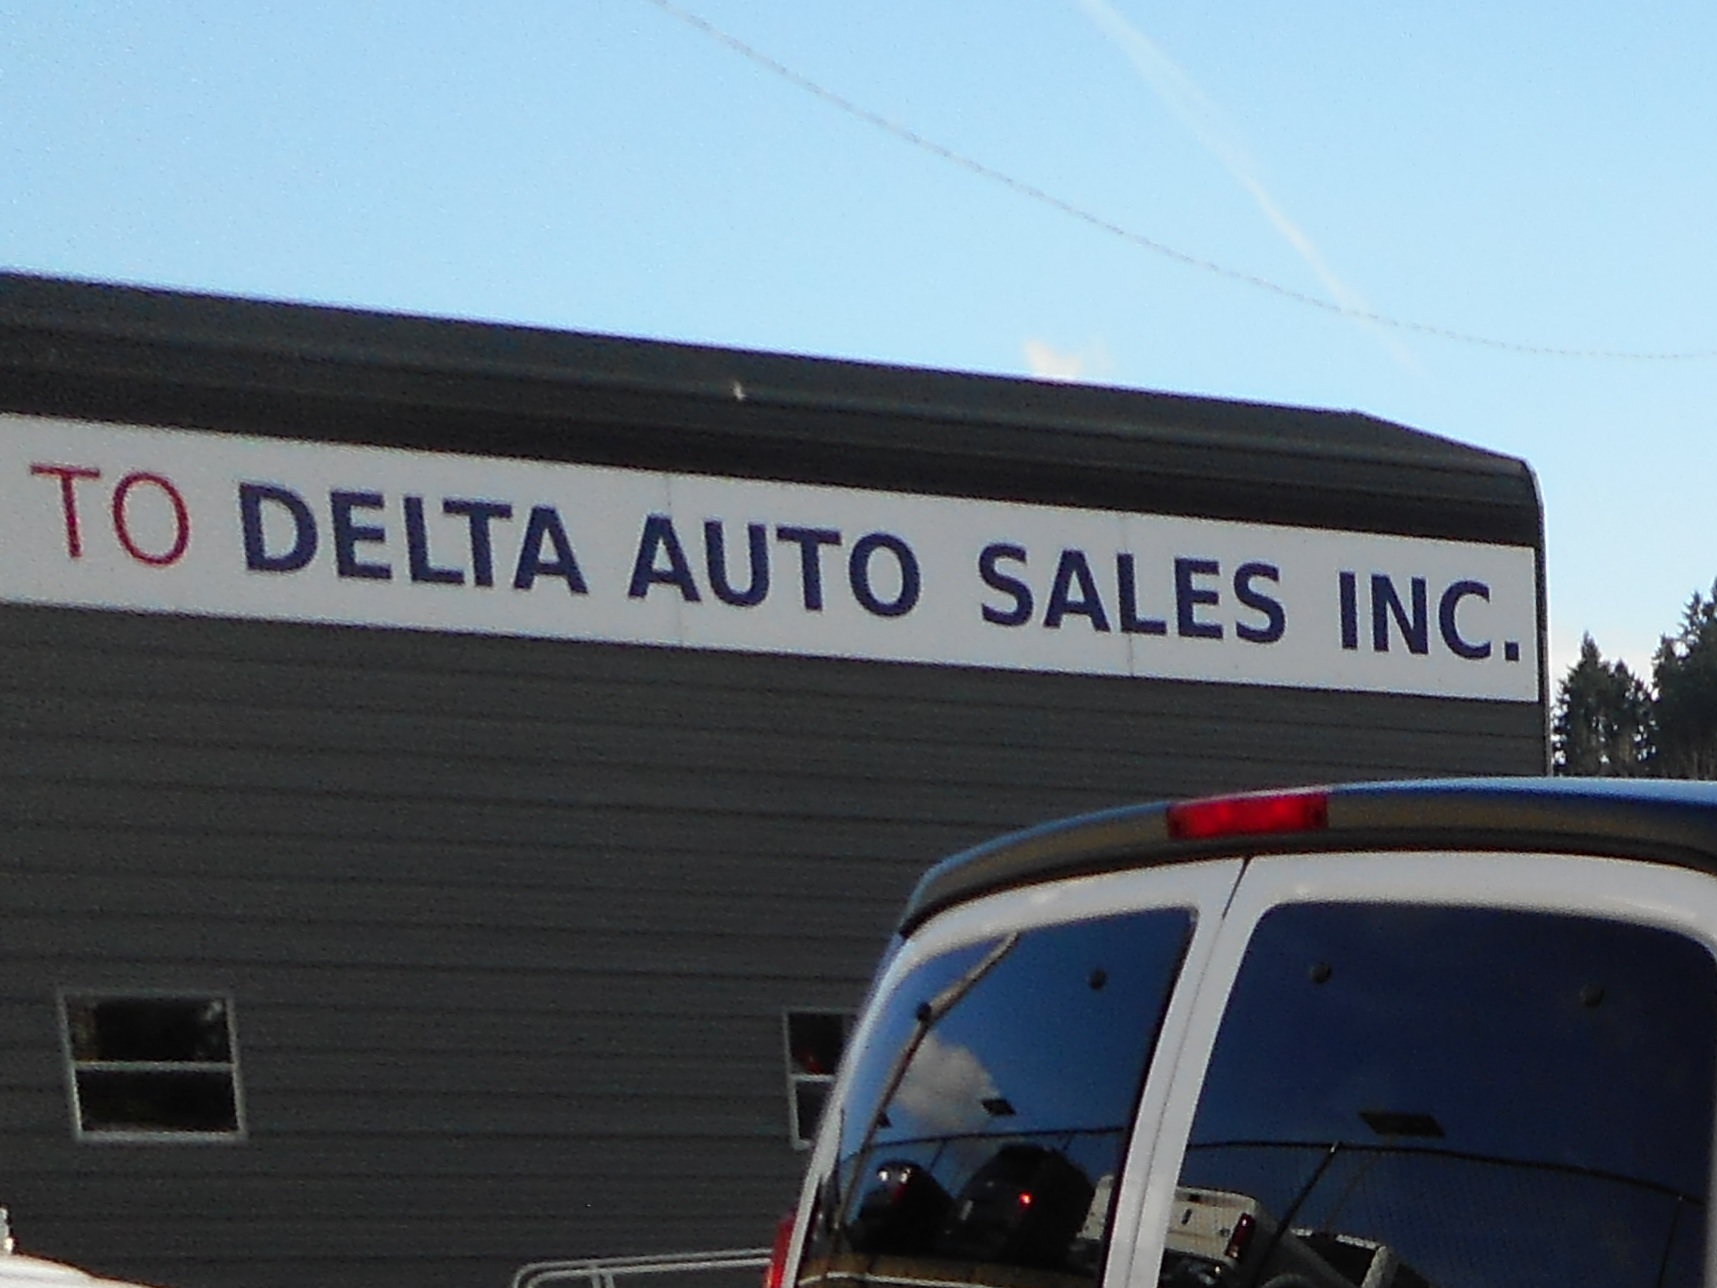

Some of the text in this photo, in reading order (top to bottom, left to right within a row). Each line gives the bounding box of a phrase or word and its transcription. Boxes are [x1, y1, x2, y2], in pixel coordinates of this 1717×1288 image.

[30, 462, 1521, 662] TO DELTA AUTO SALES INC.
